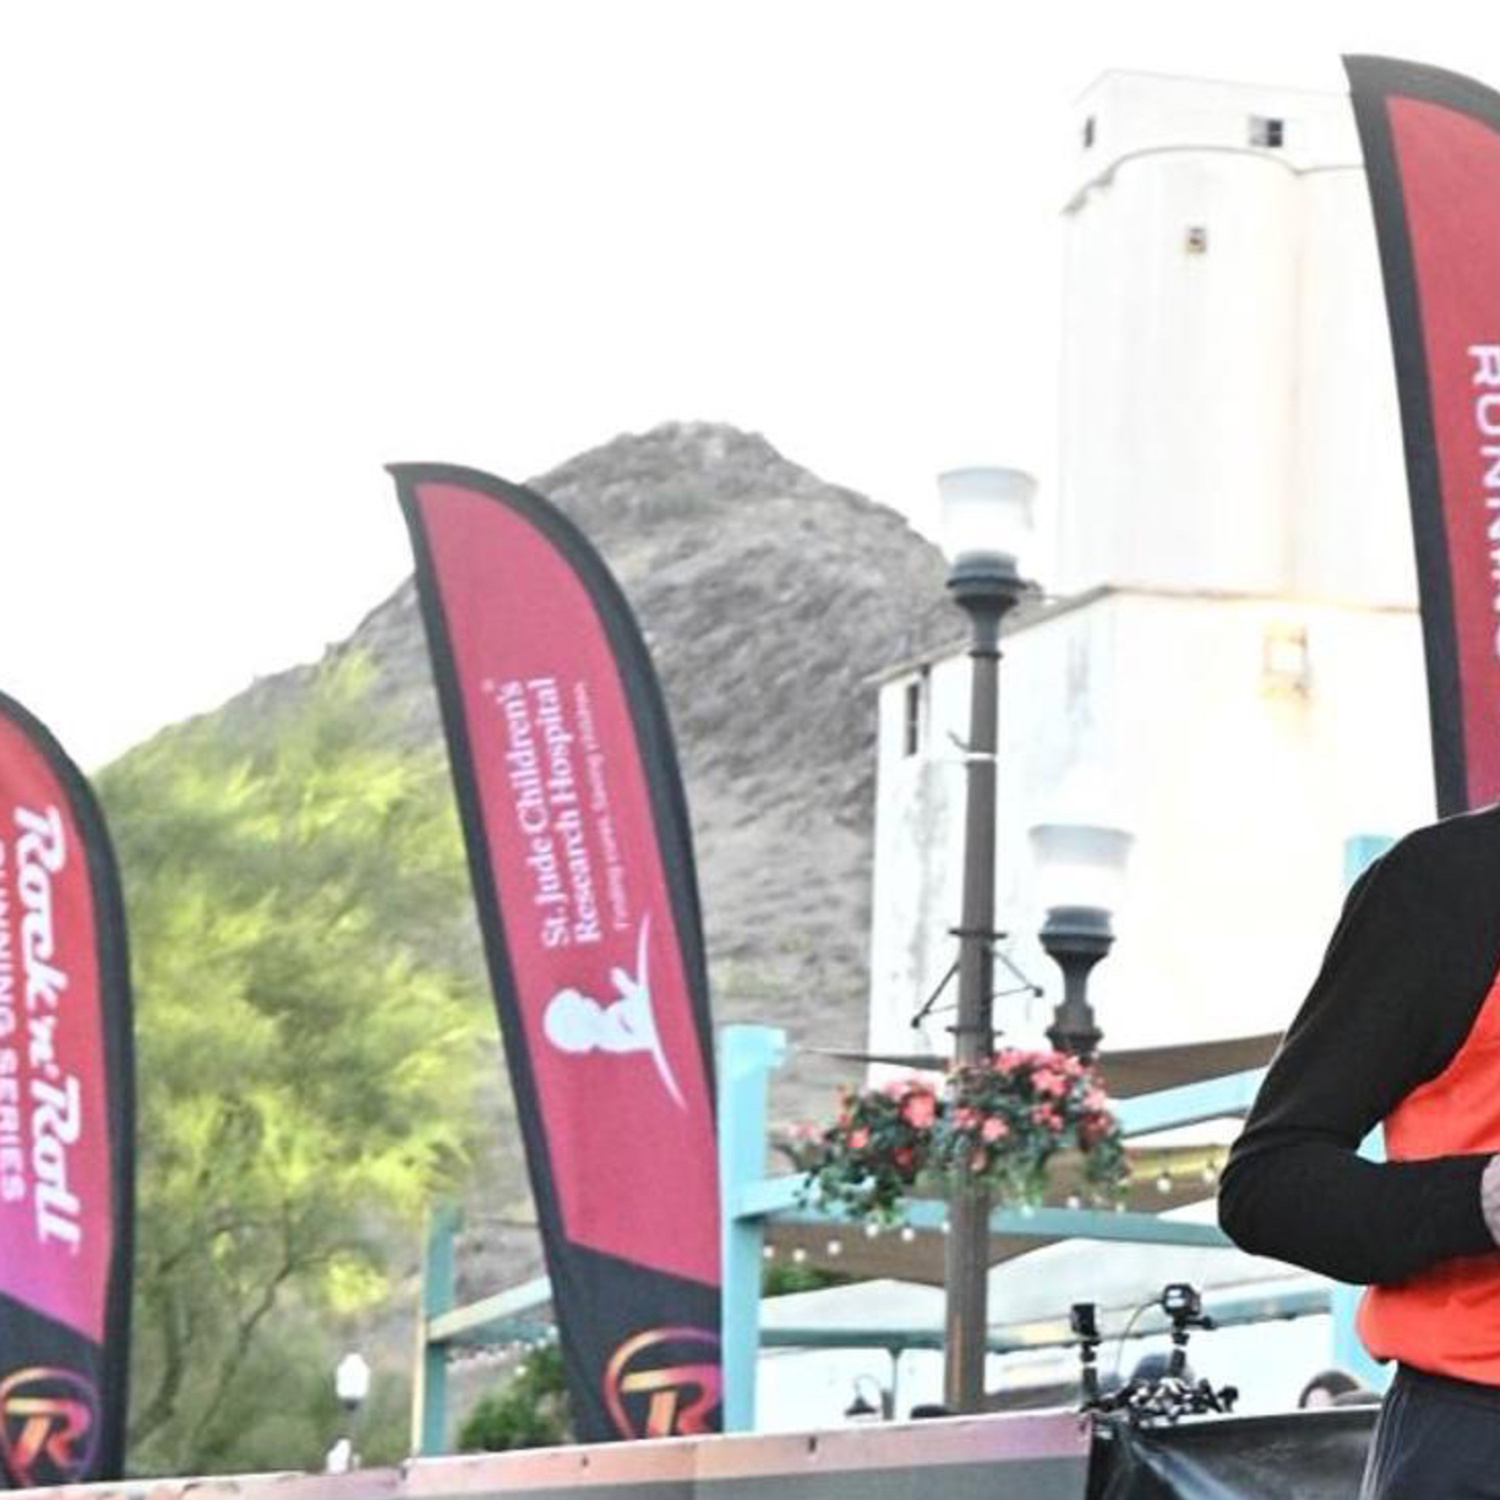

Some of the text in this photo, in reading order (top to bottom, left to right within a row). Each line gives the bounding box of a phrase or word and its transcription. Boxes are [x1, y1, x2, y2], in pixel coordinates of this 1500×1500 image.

[495, 680, 549, 834] Children's
[526, 677, 602, 943] Research Hospital
[525, 837, 568, 905] Jude
